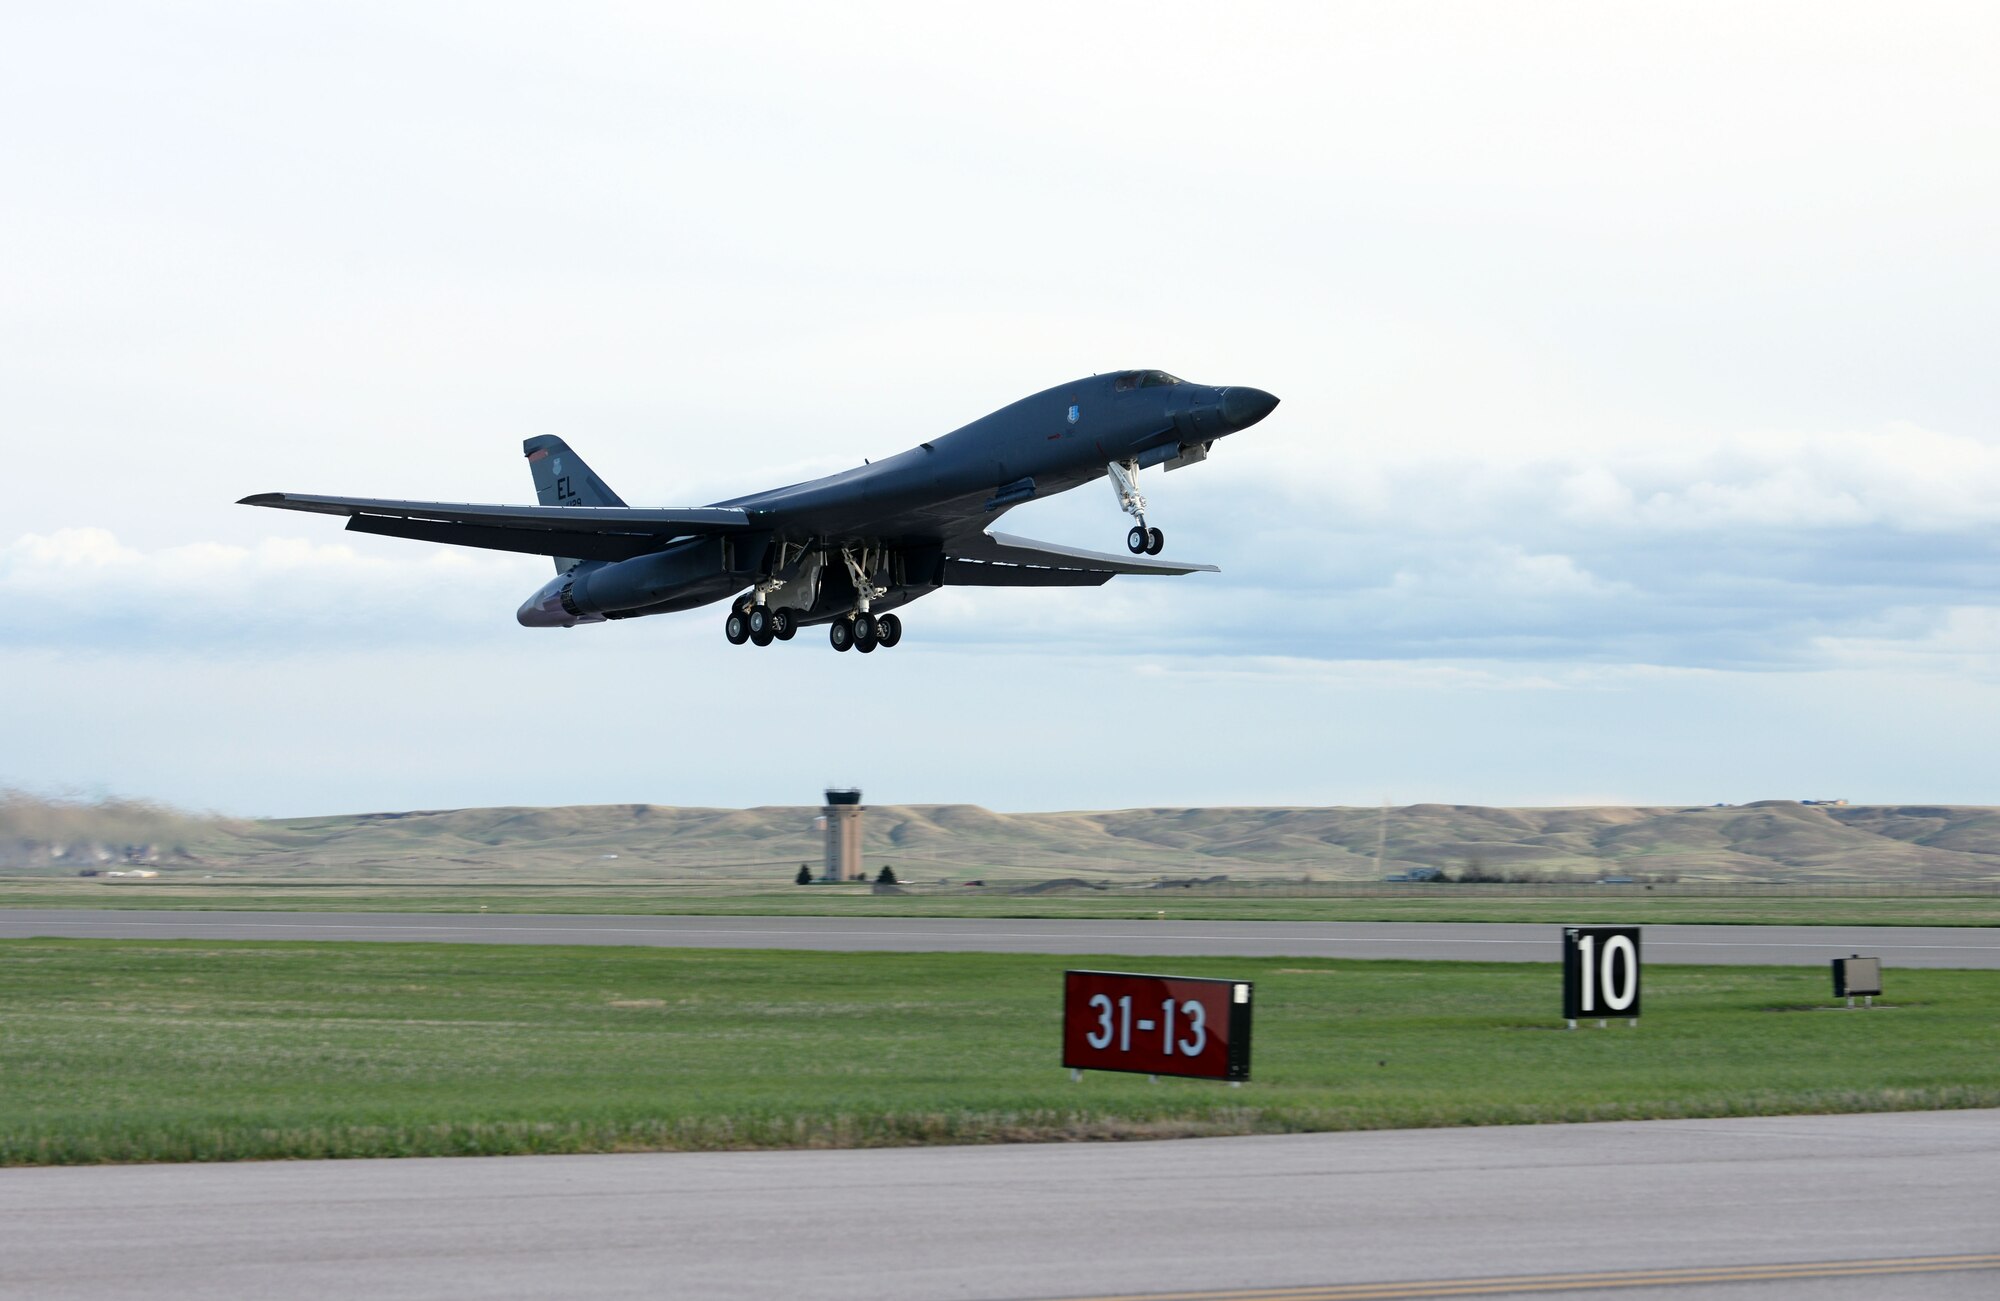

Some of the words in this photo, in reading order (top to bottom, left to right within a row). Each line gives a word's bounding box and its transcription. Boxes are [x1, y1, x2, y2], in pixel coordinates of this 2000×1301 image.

[557, 475, 576, 500] EL
[1578, 934, 1637, 1011] 10
[1086, 993, 1207, 1057] 31-13
